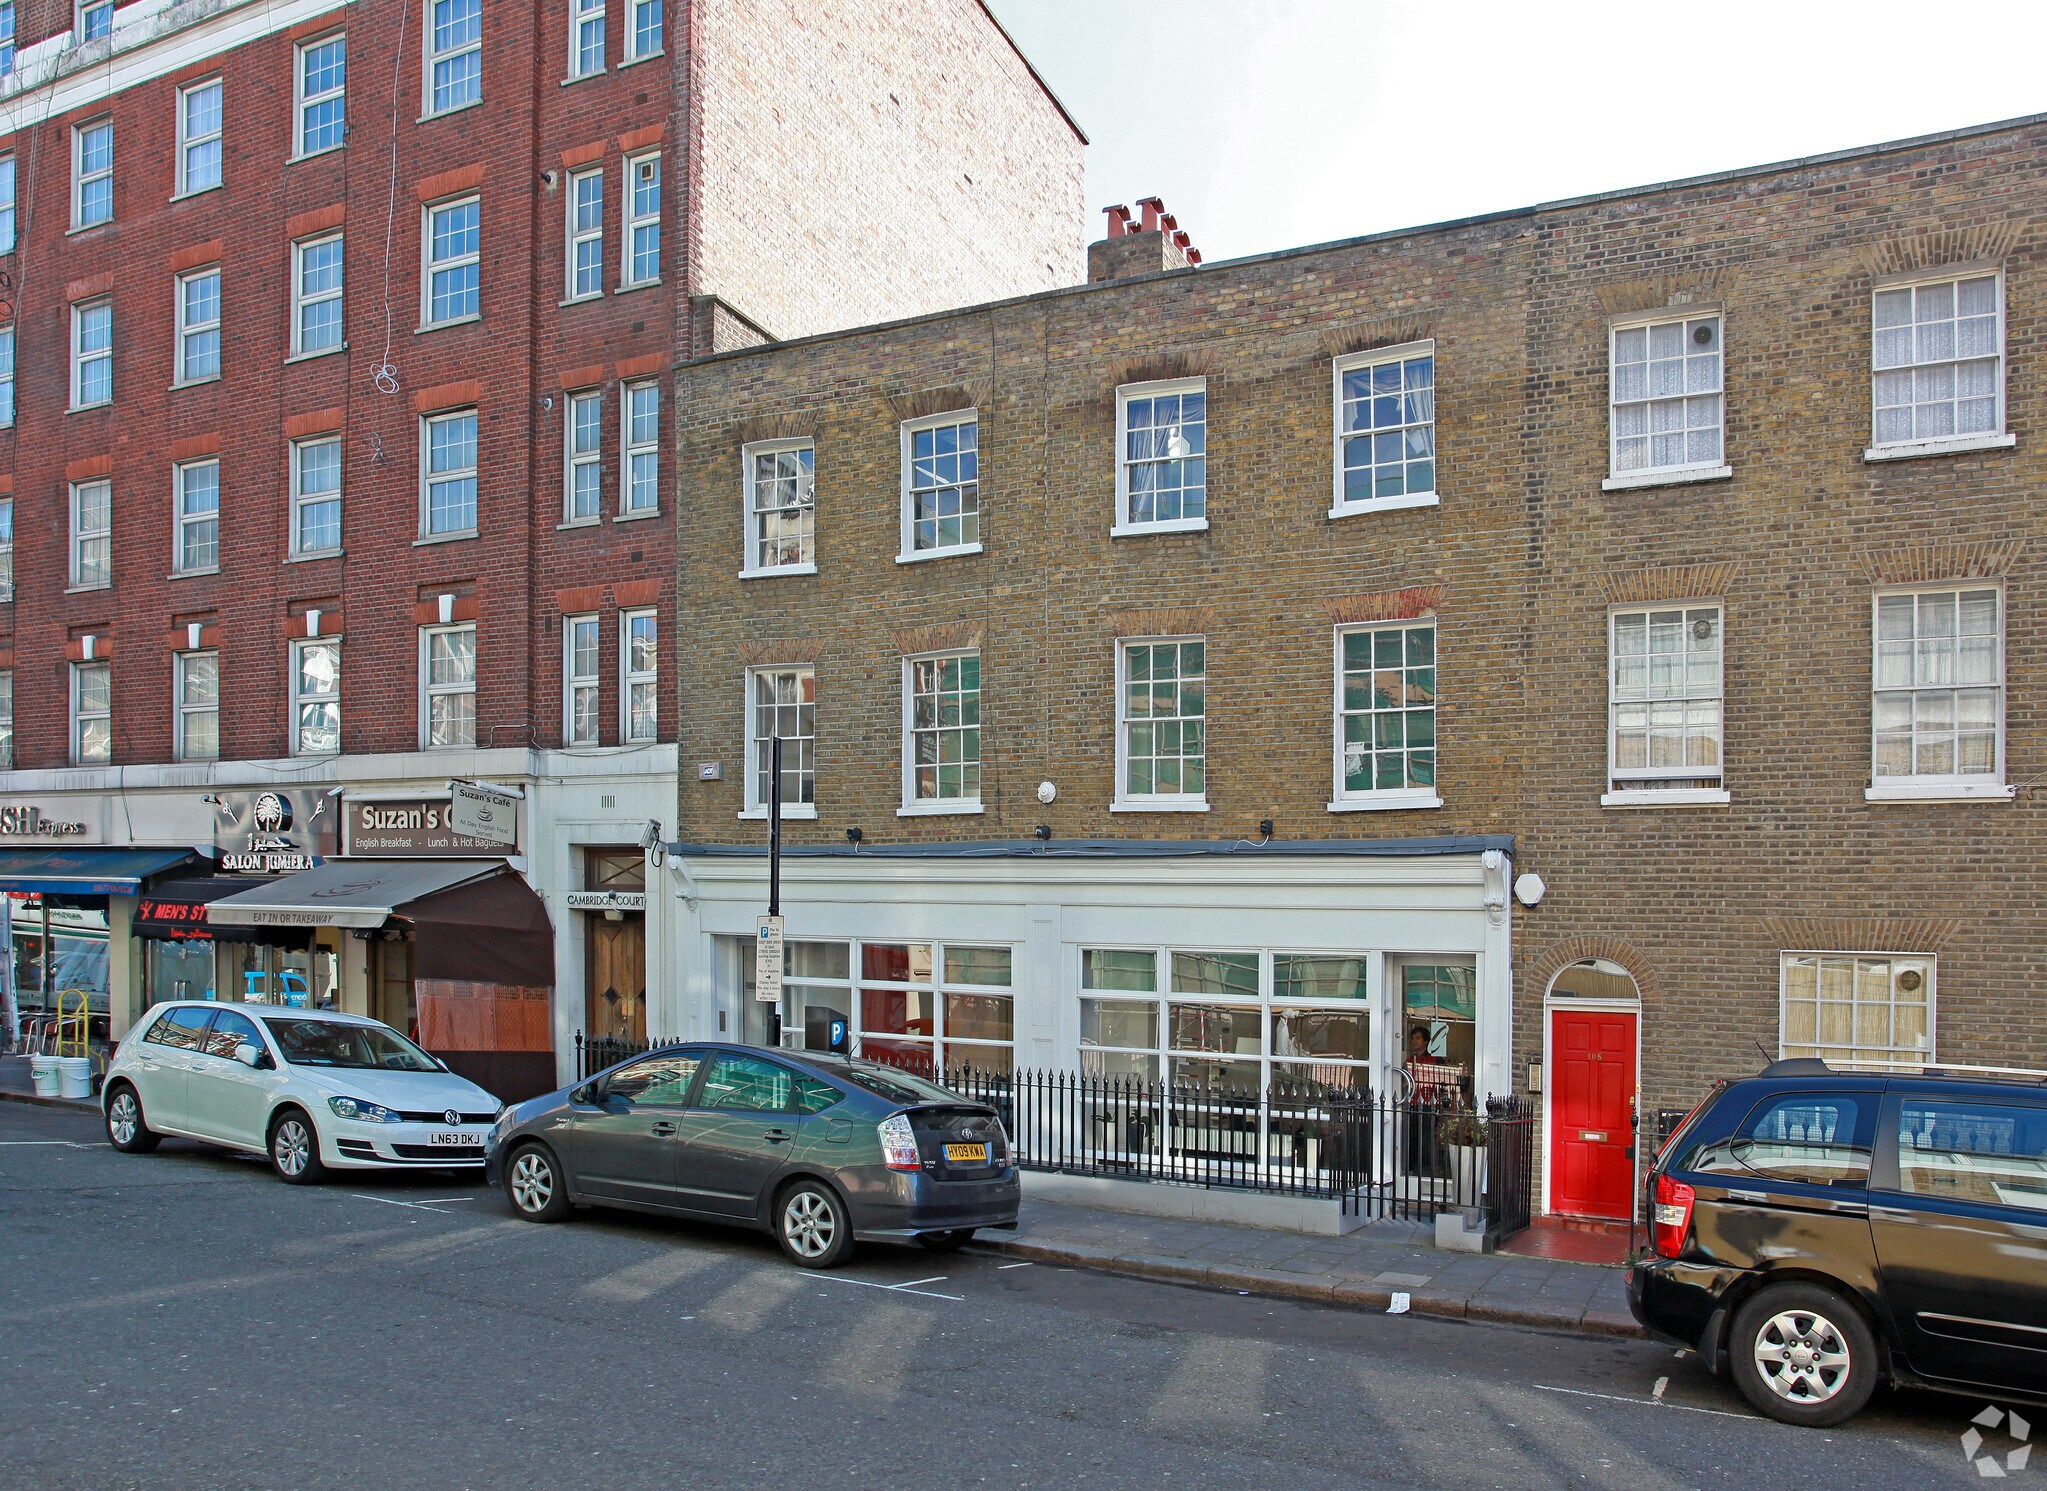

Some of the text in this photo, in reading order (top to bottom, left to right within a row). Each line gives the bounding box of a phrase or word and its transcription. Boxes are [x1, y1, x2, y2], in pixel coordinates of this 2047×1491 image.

[460, 789, 511, 808] Suzan's Café
[0, 805, 82, 838] SH Express
[362, 804, 439, 829] Suzan's
[467, 820, 478, 829] Day
[478, 822, 496, 832] English
[496, 826, 509, 835] Food
[476, 829, 493, 838] Served
[355, 837, 379, 850] English
[380, 837, 412, 848] Breakfast
[427, 836, 449, 847] Lunch
[452, 836, 459, 847] &
[460, 837, 474, 847] Hot
[222, 854, 261, 870] SALON
[616, 895, 645, 906] COURT
[154, 903, 208, 921] MEN'S ST
[253, 912, 334, 924] EAT IN OR TAKEAWAY
[1587, 1053, 1602, 1061] 105
[431, 1133, 480, 1144] LN63 DKJ
[947, 1145, 985, 1158] HY09 KWA
